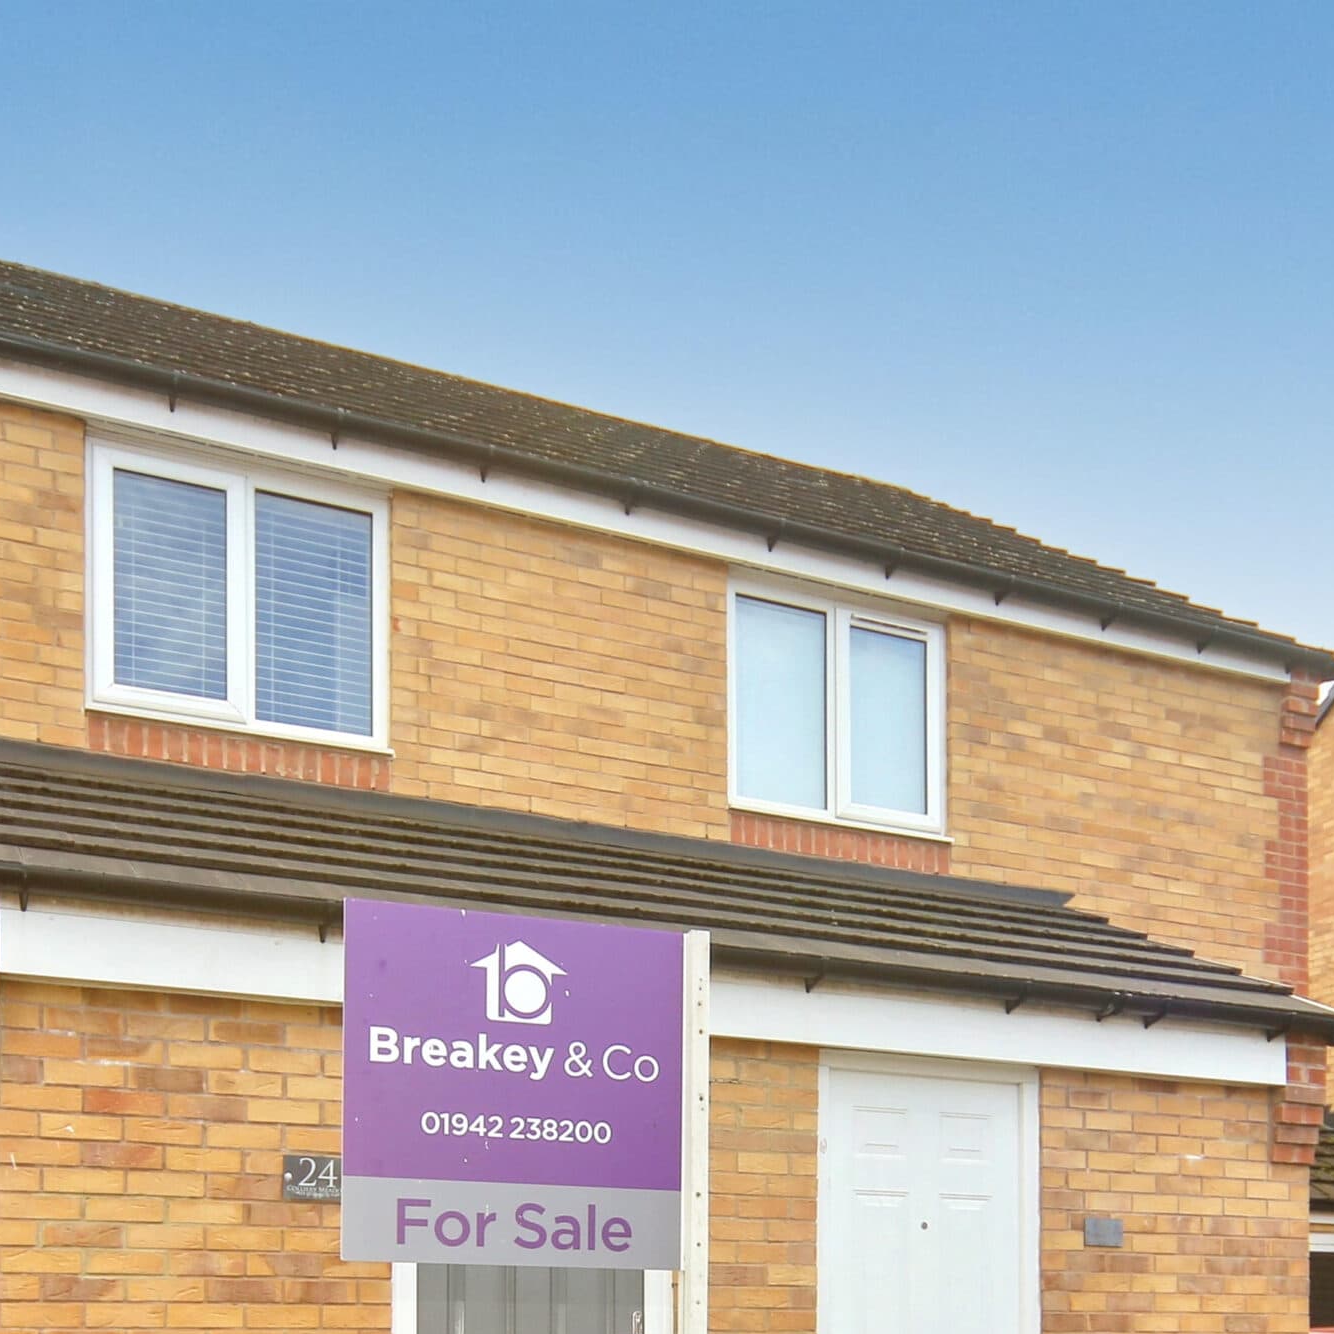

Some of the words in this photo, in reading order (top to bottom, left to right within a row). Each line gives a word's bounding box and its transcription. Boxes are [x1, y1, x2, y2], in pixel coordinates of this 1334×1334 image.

[369, 1026, 554, 1080] Breakey
[564, 1041, 593, 1078] &
[602, 1045, 660, 1082] Co
[420, 1111, 503, 1138] 01942
[509, 1117, 612, 1144] 238200
[298, 1157, 338, 1188] 24
[397, 1199, 495, 1247] For
[514, 1203, 632, 1251] Sale
